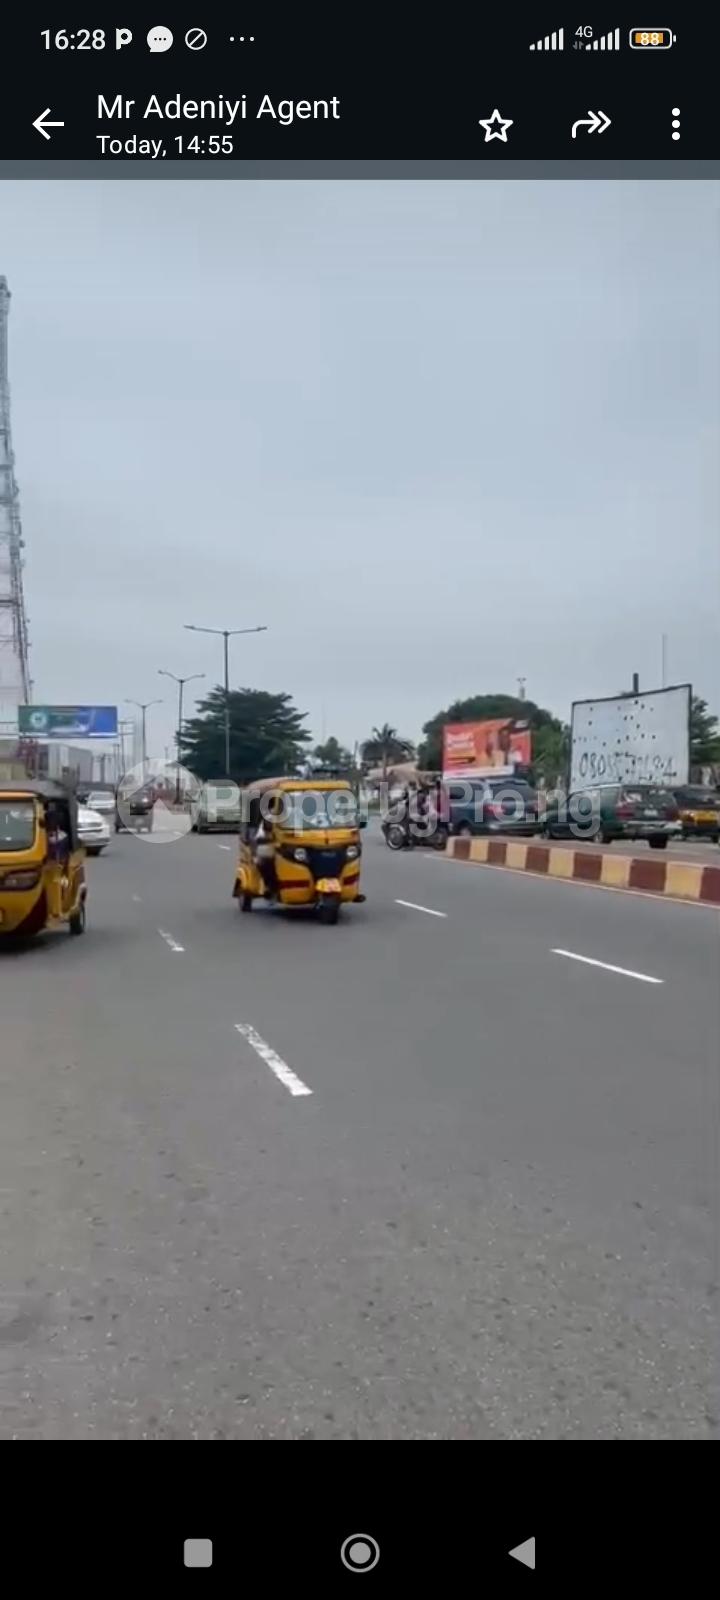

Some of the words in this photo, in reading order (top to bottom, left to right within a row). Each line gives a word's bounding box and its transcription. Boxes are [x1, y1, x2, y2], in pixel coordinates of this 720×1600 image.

[40, 28, 106, 51] 16:28
[574, 25, 594, 38] 4G
[640, 32, 660, 46] 88
[97, 94, 136, 119] Mr
[143, 93, 248, 126] Adeniyi
[256, 94, 342, 126] Agent
[96, 135, 167, 159] Today,
[174, 135, 234, 155] 14:55
